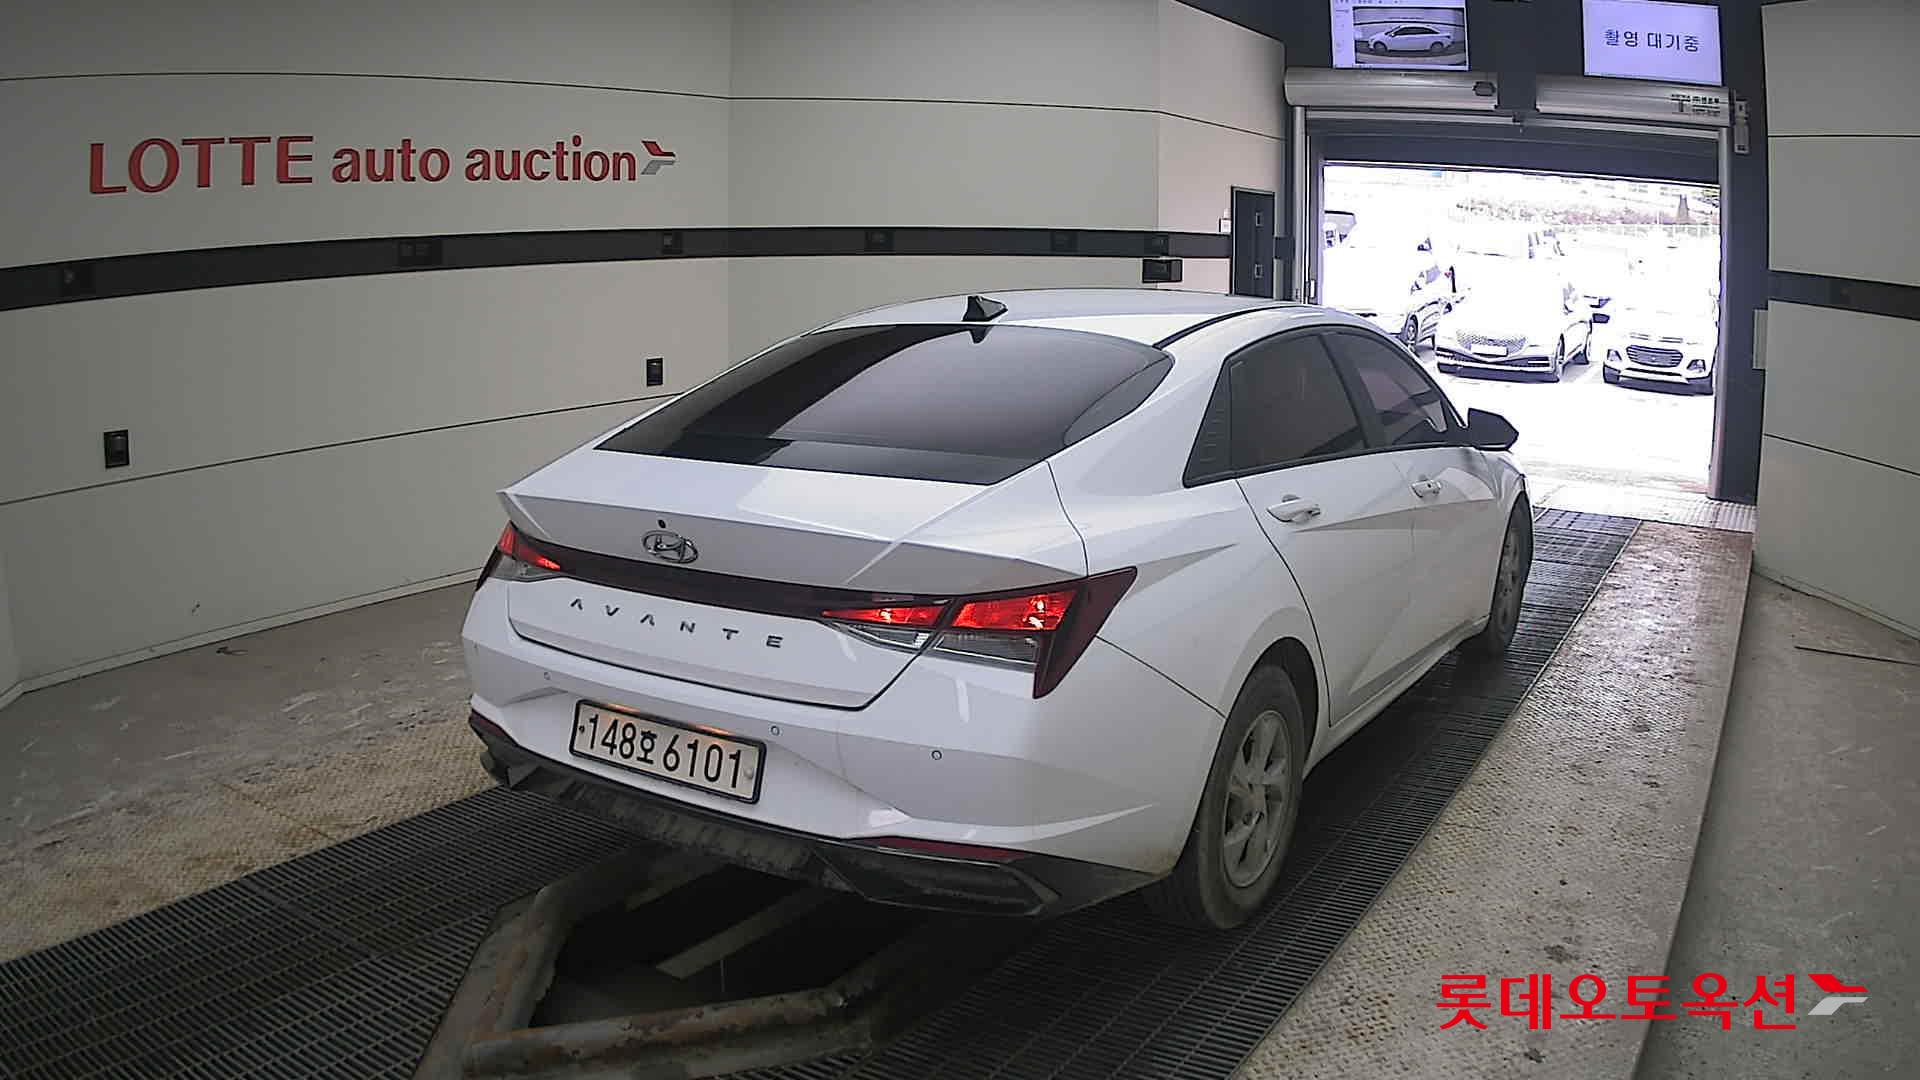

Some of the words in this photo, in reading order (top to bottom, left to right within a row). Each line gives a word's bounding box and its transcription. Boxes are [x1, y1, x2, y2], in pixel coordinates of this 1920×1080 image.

[1605, 29, 1638, 48] 촬영
[1647, 32, 1699, 52] 대기중
[89, 135, 314, 194] LOTTE
[331, 138, 450, 183] auto
[464, 135, 637, 181] auction
[570, 598, 783, 648] AVANTE
